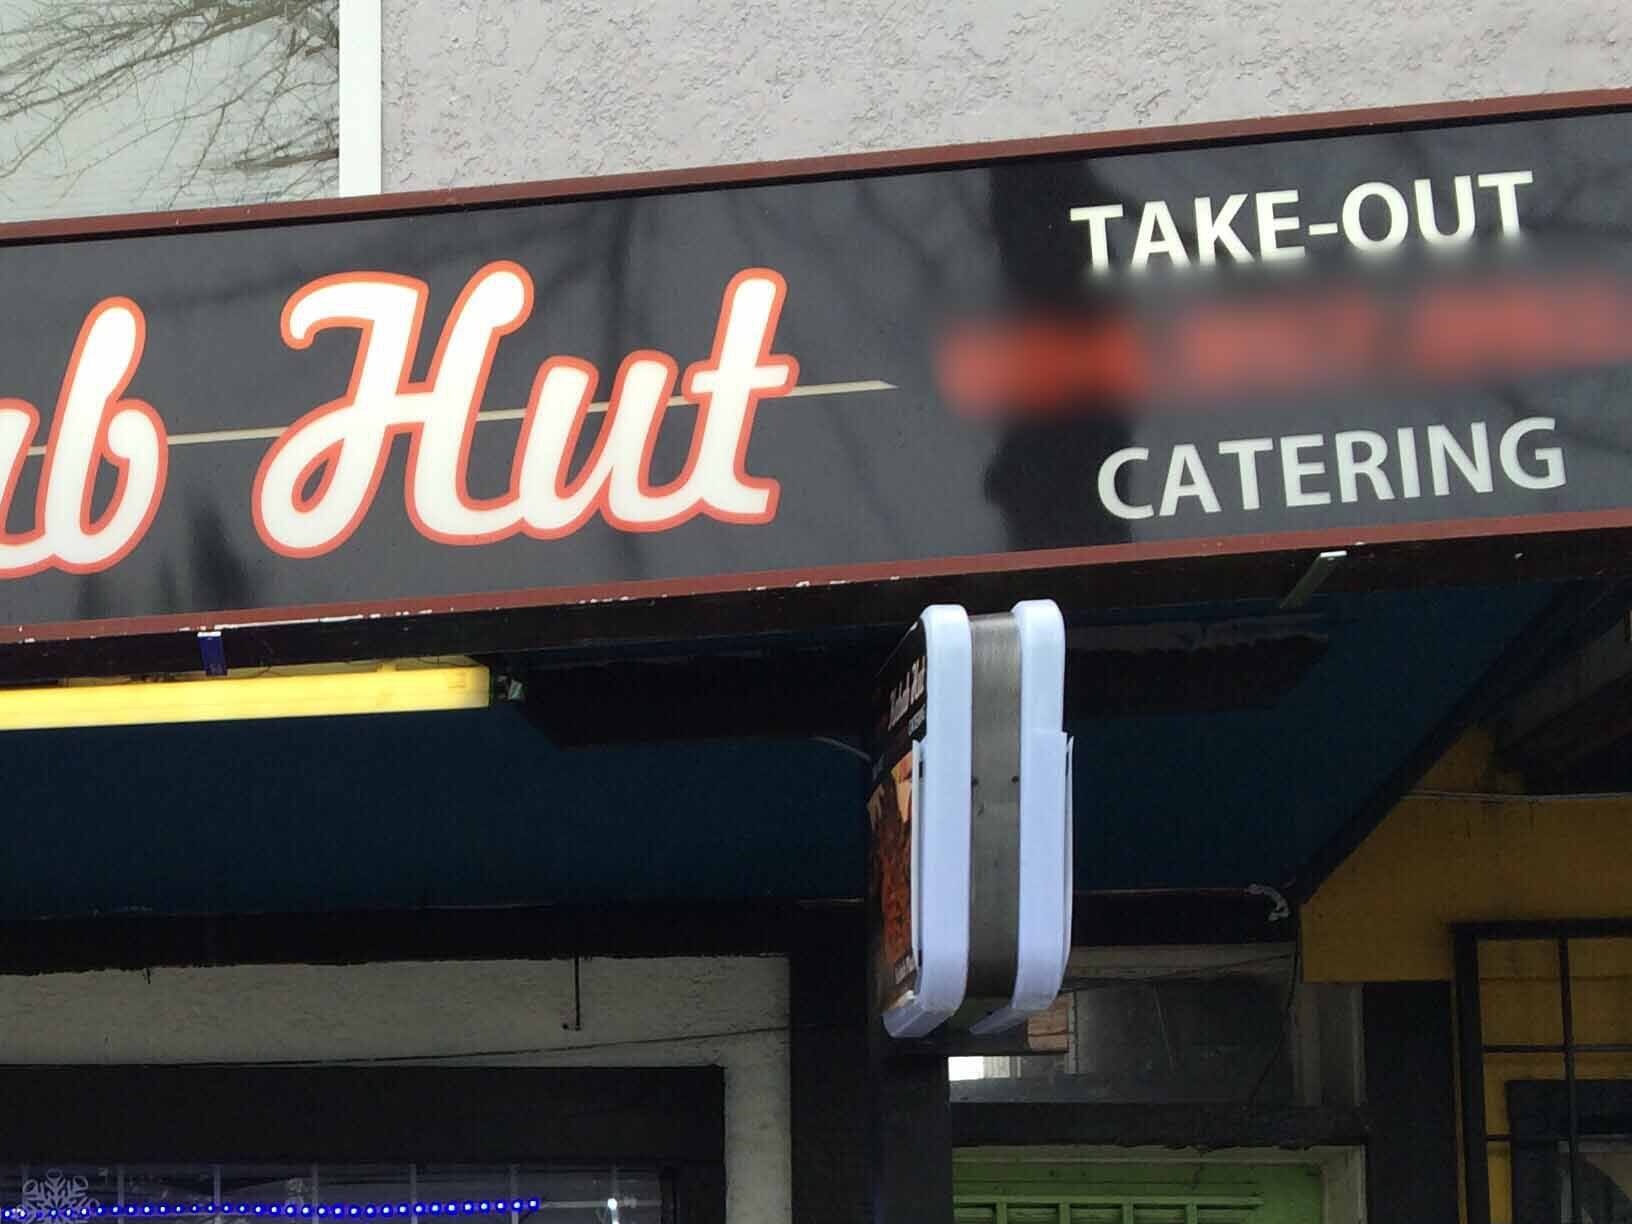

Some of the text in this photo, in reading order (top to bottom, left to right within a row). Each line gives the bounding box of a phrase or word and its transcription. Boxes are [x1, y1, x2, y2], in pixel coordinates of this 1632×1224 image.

[1069, 170, 1533, 274] TAKE-OUT
[253, 259, 798, 559] Hut
[1097, 417, 1567, 520] CATERING
